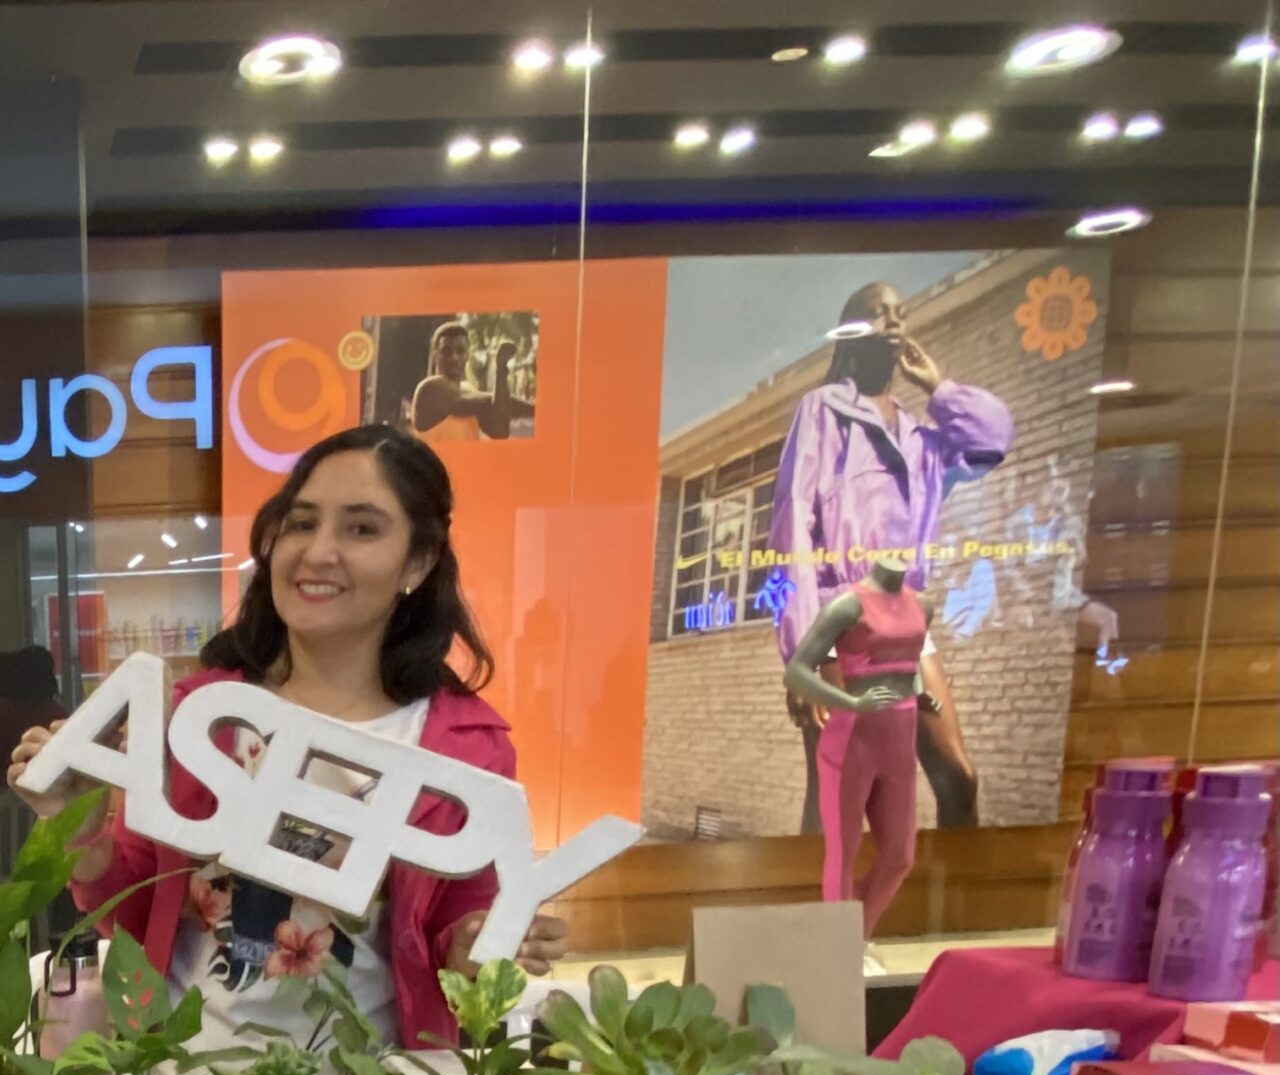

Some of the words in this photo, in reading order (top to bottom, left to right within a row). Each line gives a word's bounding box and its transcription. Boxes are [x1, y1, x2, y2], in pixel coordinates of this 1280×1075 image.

[721, 549, 744, 567] El
[925, 543, 956, 560] En
[16, 652, 645, 963] ASEPY
